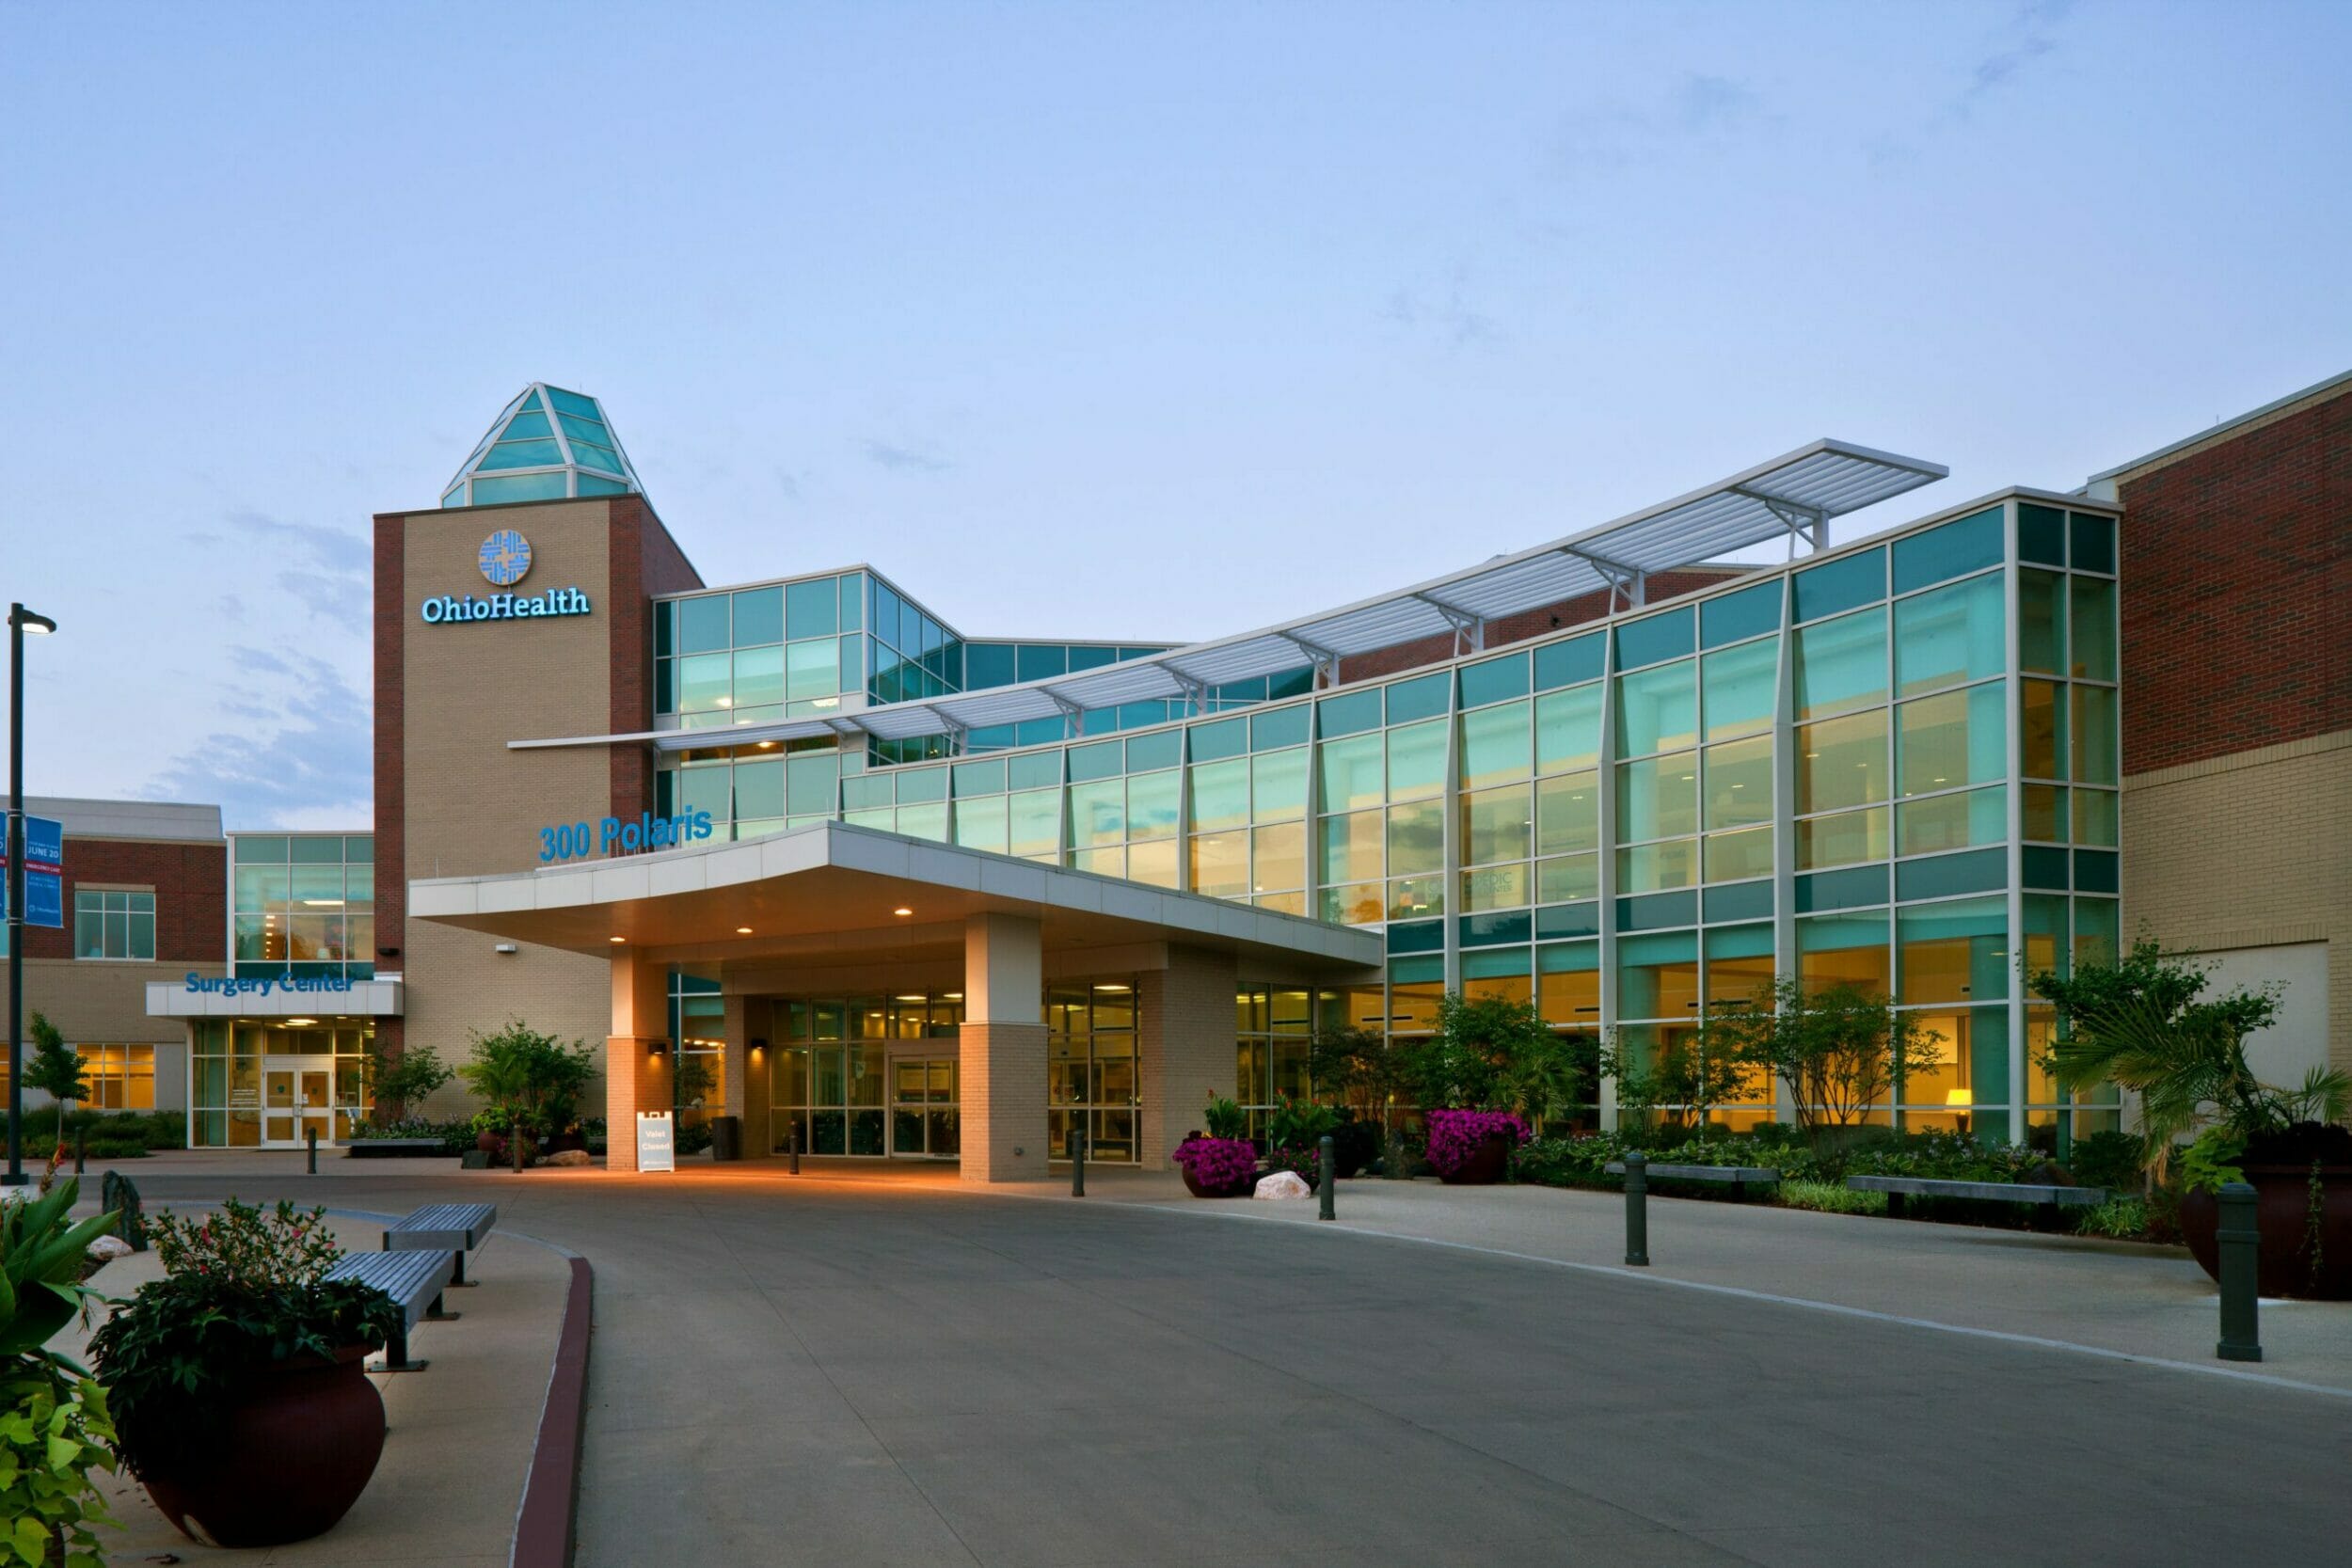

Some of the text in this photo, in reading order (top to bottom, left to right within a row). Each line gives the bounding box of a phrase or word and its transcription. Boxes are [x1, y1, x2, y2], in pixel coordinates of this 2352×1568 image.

[421, 587, 590, 624] OhioHealth
[539, 804, 713, 863] 300 Polaris
[28, 847, 59, 859] JUNE 20
[185, 972, 356, 998] Surgery Center
[645, 1130, 666, 1138] Valet
[642, 1142, 671, 1151] Closed
